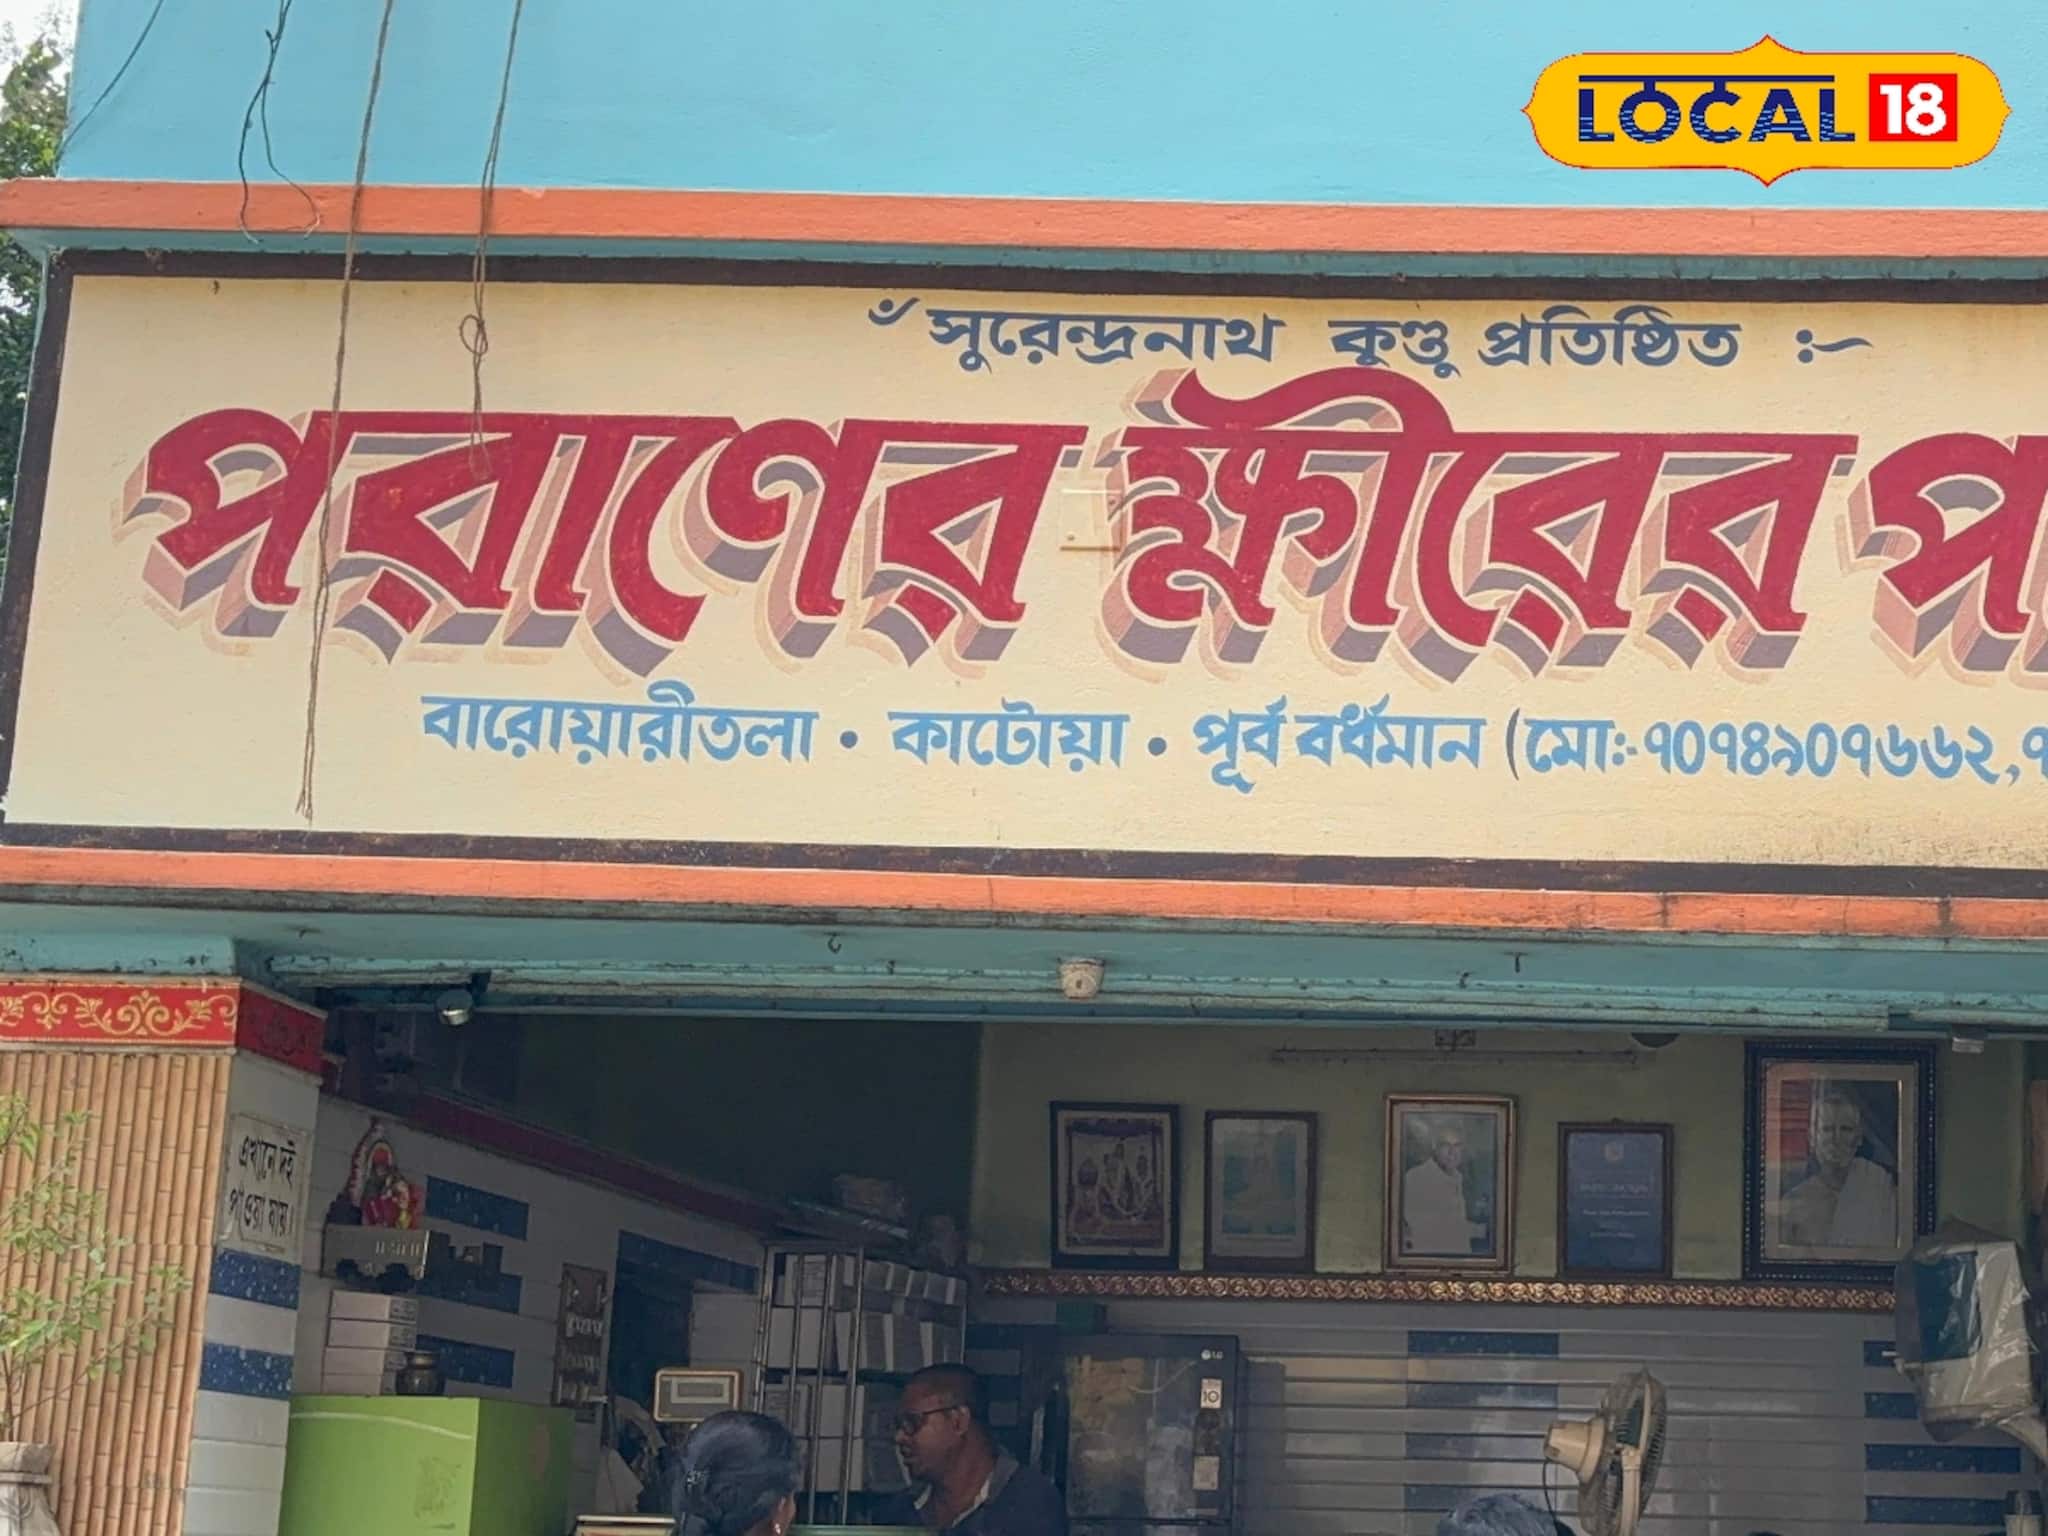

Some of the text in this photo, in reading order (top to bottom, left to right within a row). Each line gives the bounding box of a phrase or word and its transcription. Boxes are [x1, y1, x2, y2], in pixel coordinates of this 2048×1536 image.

[1478, 304, 1742, 368] প্রতিষ্ঠিত
[143, 407, 1089, 655] পরাণের
[1120, 365, 1861, 655] ক্ষীরের
[421, 679, 820, 764] বারোয়ারীতলা
[887, 697, 1131, 772] কাটোয়া
[1192, 694, 1289, 794] পূর্ব
[1294, 693, 1488, 768] বর্ধমান
